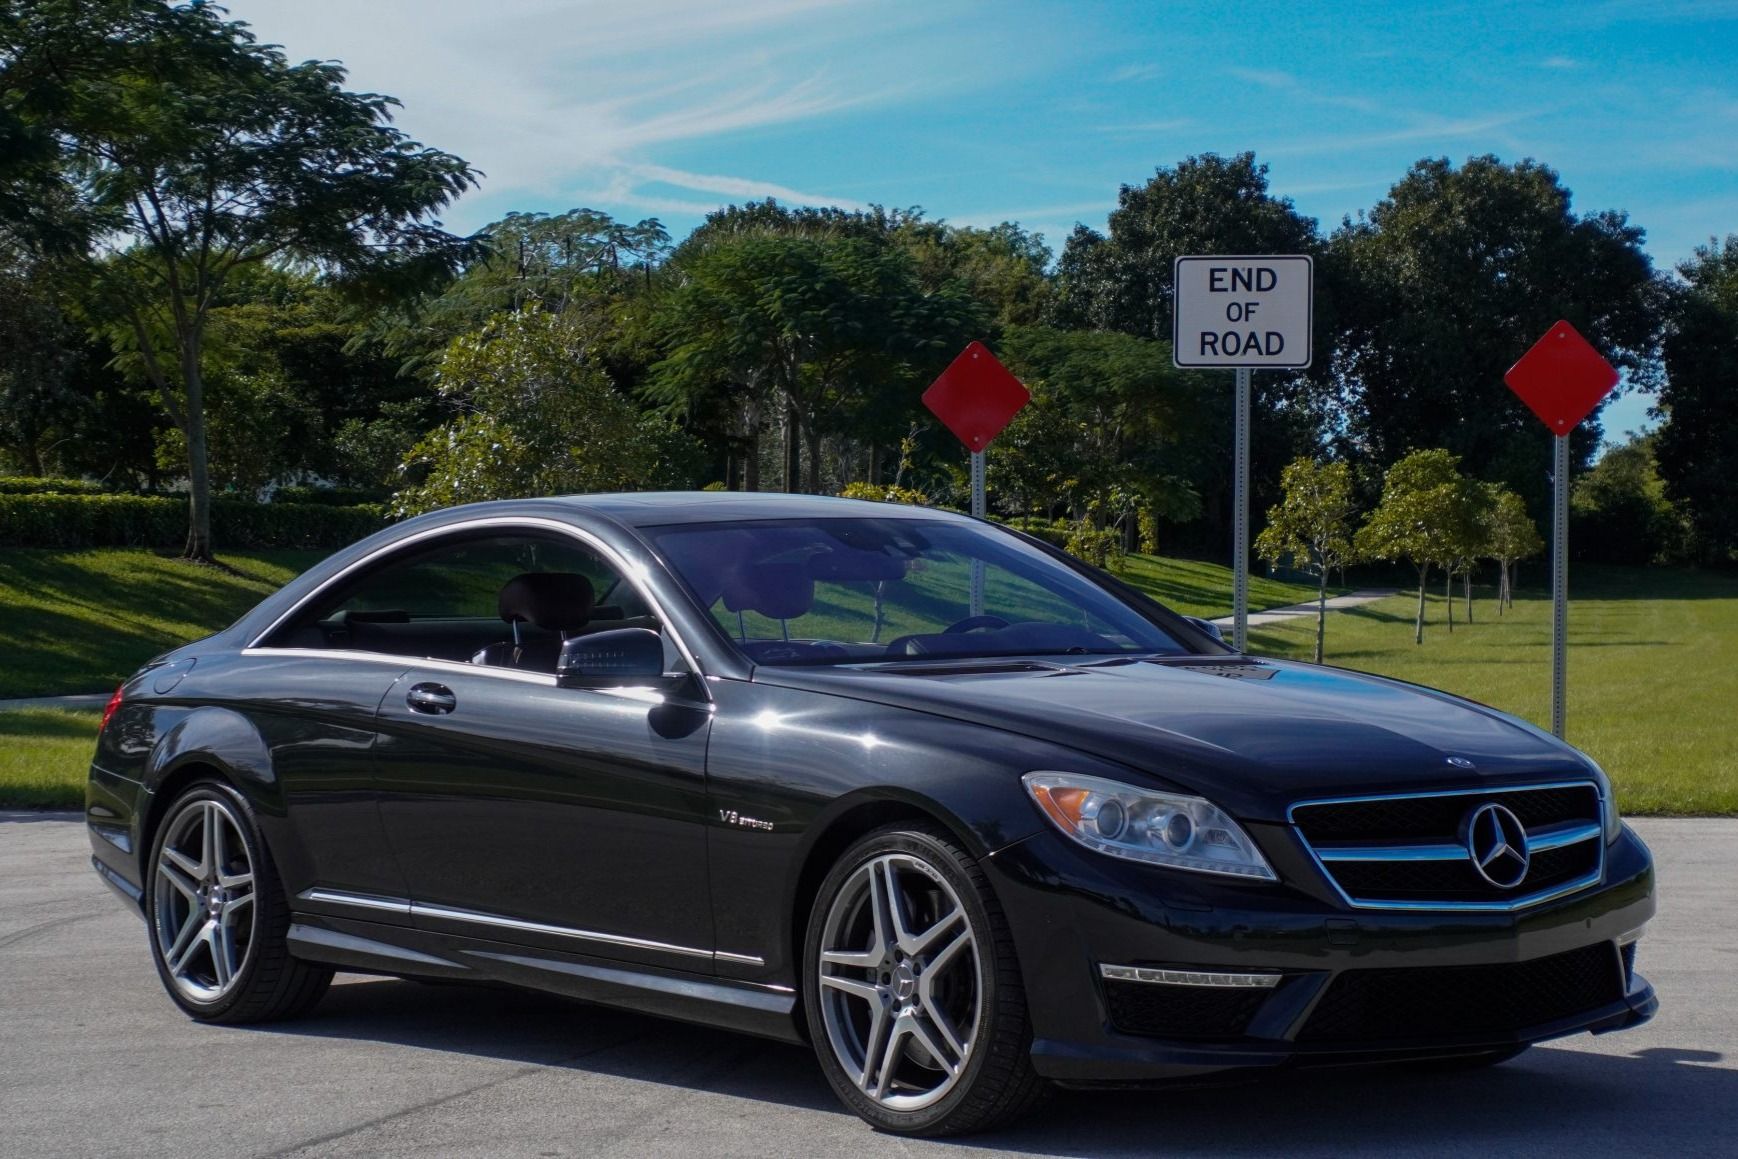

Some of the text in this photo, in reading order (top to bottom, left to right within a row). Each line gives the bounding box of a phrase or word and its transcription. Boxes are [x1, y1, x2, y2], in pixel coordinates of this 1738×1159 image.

[1209, 267, 1278, 293] END
[1226, 302, 1260, 322] OF
[1200, 331, 1285, 356] ROAD
[719, 809, 738, 824] V8
